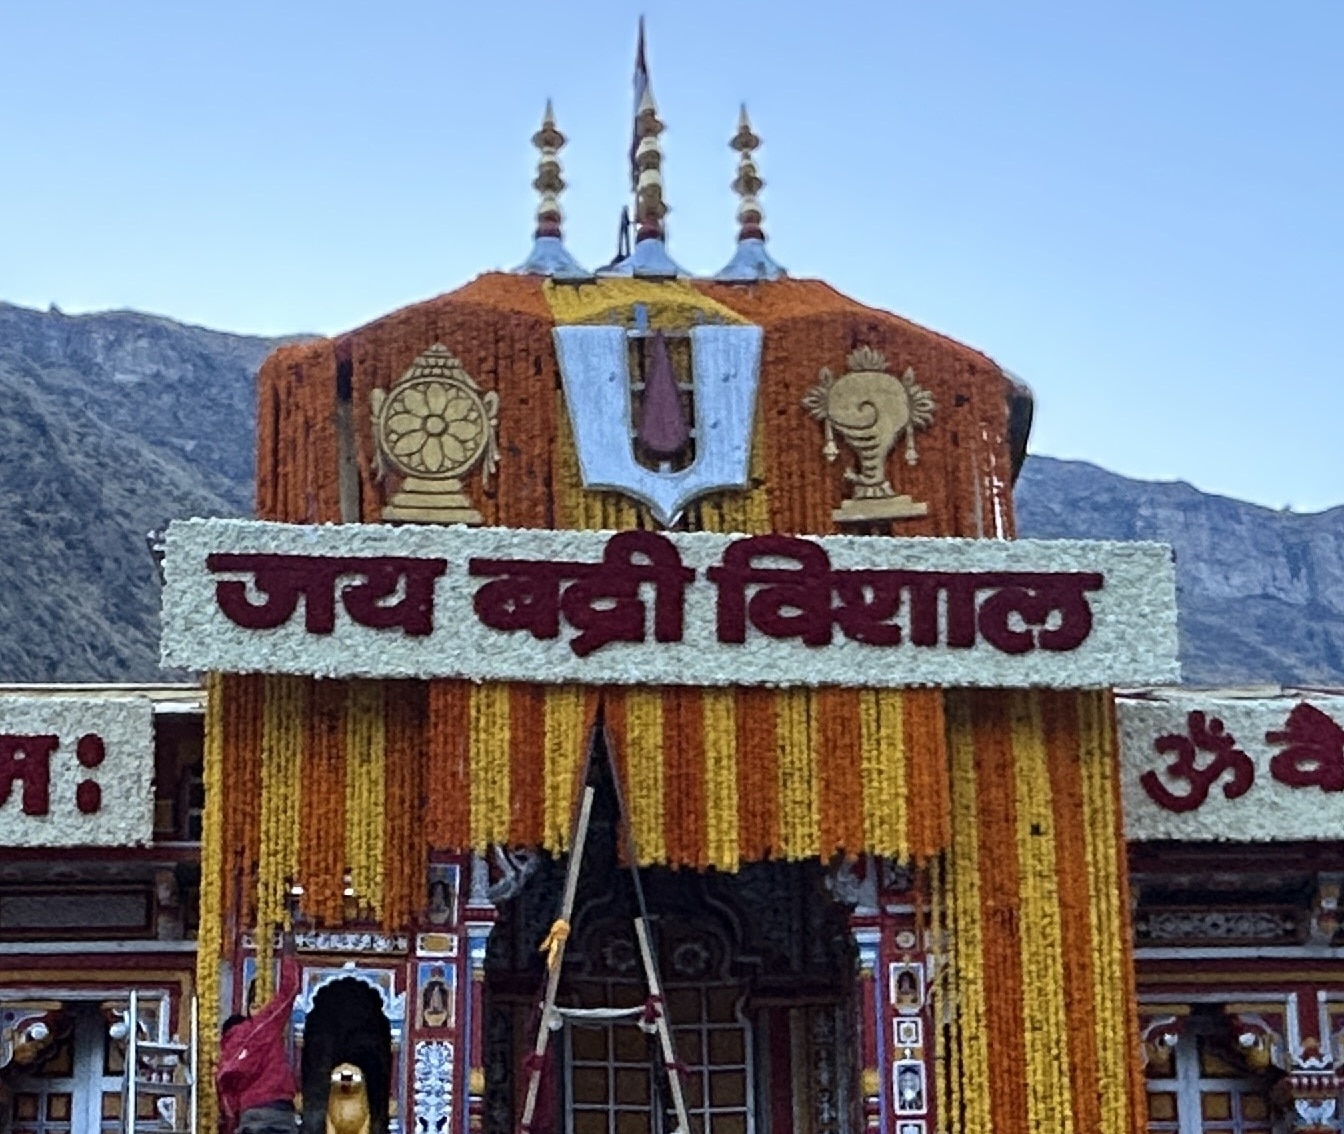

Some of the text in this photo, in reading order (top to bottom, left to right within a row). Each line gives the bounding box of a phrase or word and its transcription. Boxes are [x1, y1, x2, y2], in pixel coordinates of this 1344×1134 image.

[206, 531, 1104, 657] जय बद्री विशाल
[1140, 710, 1254, 812] ॐ
